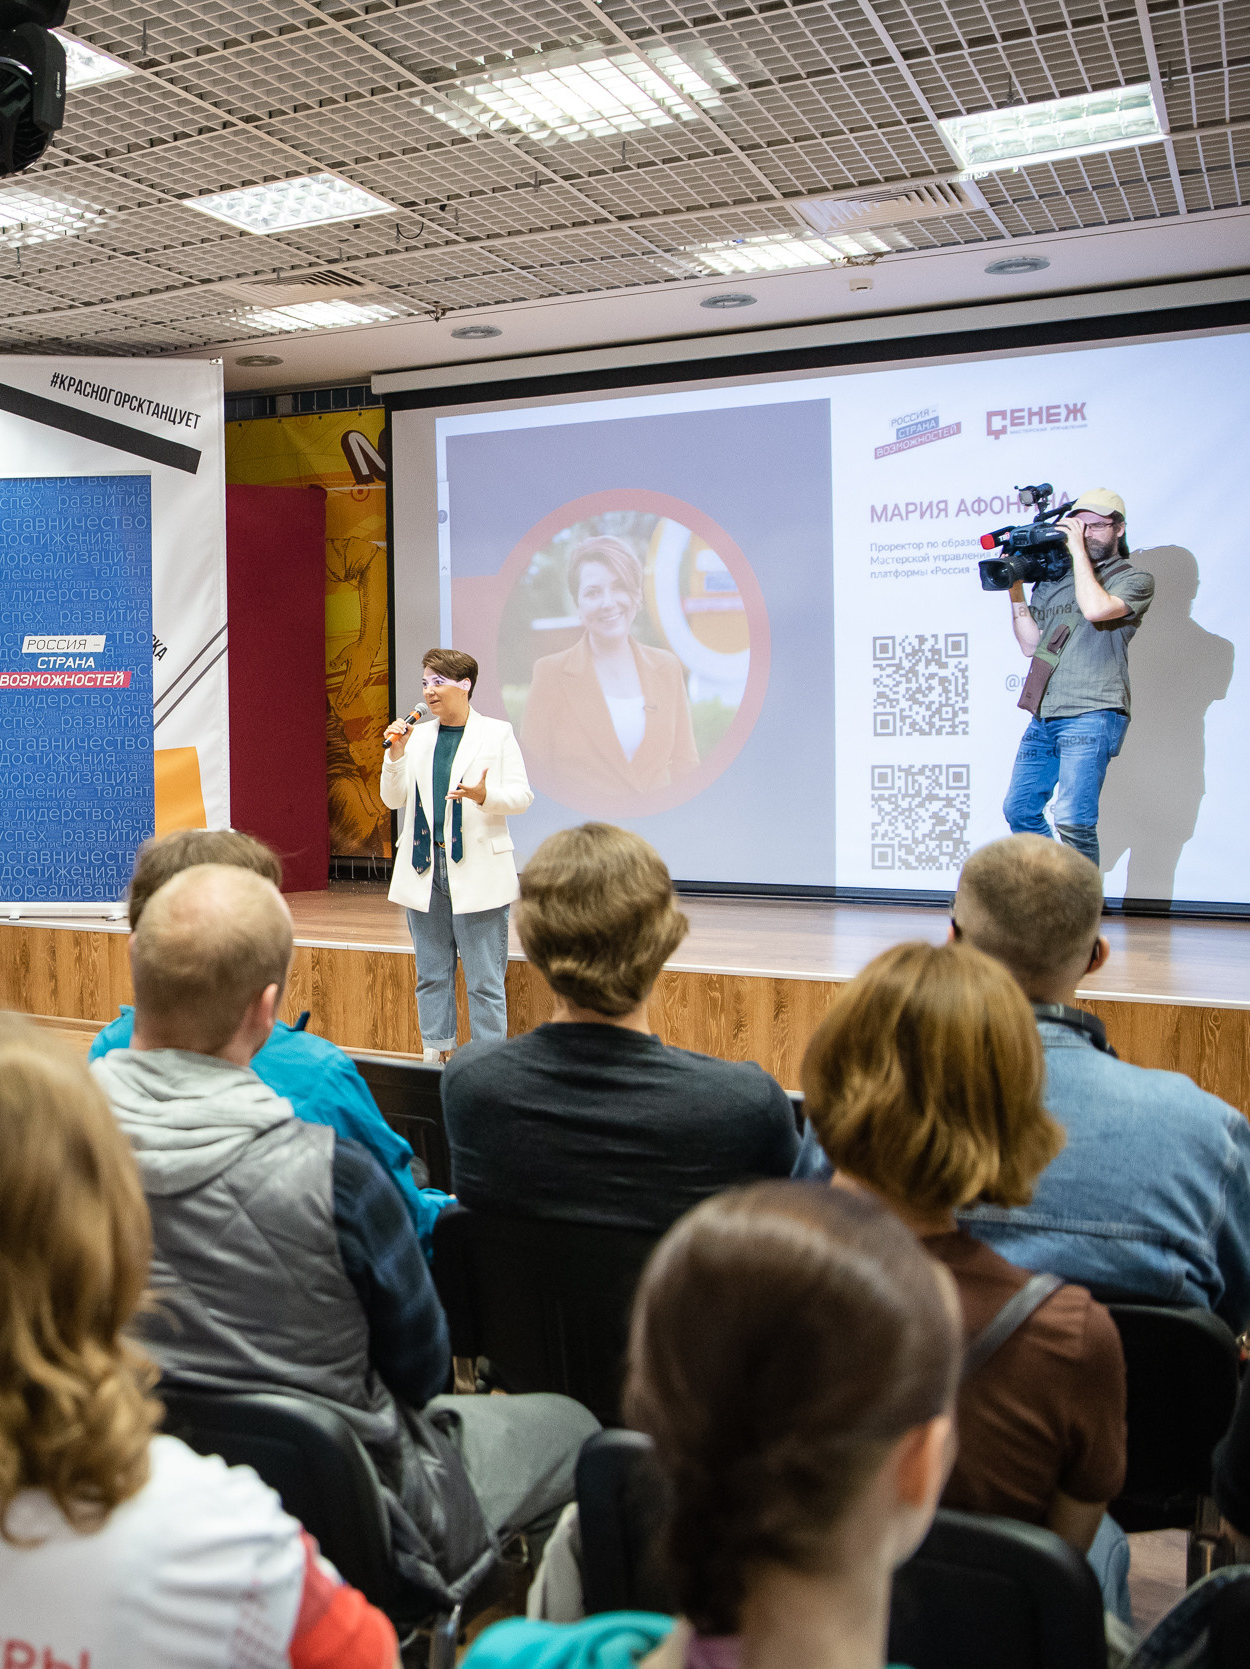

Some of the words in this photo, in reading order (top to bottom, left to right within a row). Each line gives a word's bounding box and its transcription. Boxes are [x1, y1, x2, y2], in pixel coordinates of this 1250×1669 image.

[50, 372, 201, 429] #КРАСНОГОРСКТАНЦУЕТ
[891, 408, 930, 427] РОССИЯ
[897, 419, 937, 439] СТРАНА
[875, 423, 958, 458] ВОЗМОЖНОСТЕЙ
[107, 484, 149, 494] мечта
[58, 494, 148, 511] развитие
[870, 500, 949, 523] МАРИЯ
[955, 491, 1071, 518] АФОНА
[870, 541, 924, 553] Проректор
[927, 540, 939, 549] по
[942, 537, 981, 548] образов
[870, 553, 930, 566] Мастерской
[932, 551, 992, 564] управления
[93, 566, 149, 577] талант
[870, 568, 928, 580] платформы
[930, 565, 970, 577] «Россия
[11, 588, 112, 604] лидерство
[108, 599, 150, 609] мечта
[60, 609, 150, 626] развитие
[26, 639, 87, 650] РОССИЯ
[37, 656, 95, 669] СТРАНА
[0, 671, 125, 687] ВОЗМОЖНОСТЕЙ
[13, 693, 113, 709] лидерство
[61, 715, 150, 731] развитие
[0, 752, 116, 767] достижения
[95, 786, 150, 797] талант
[14, 808, 114, 823] лидерство
[62, 829, 151, 845] развитие
[1, 866, 117, 880] достижения
